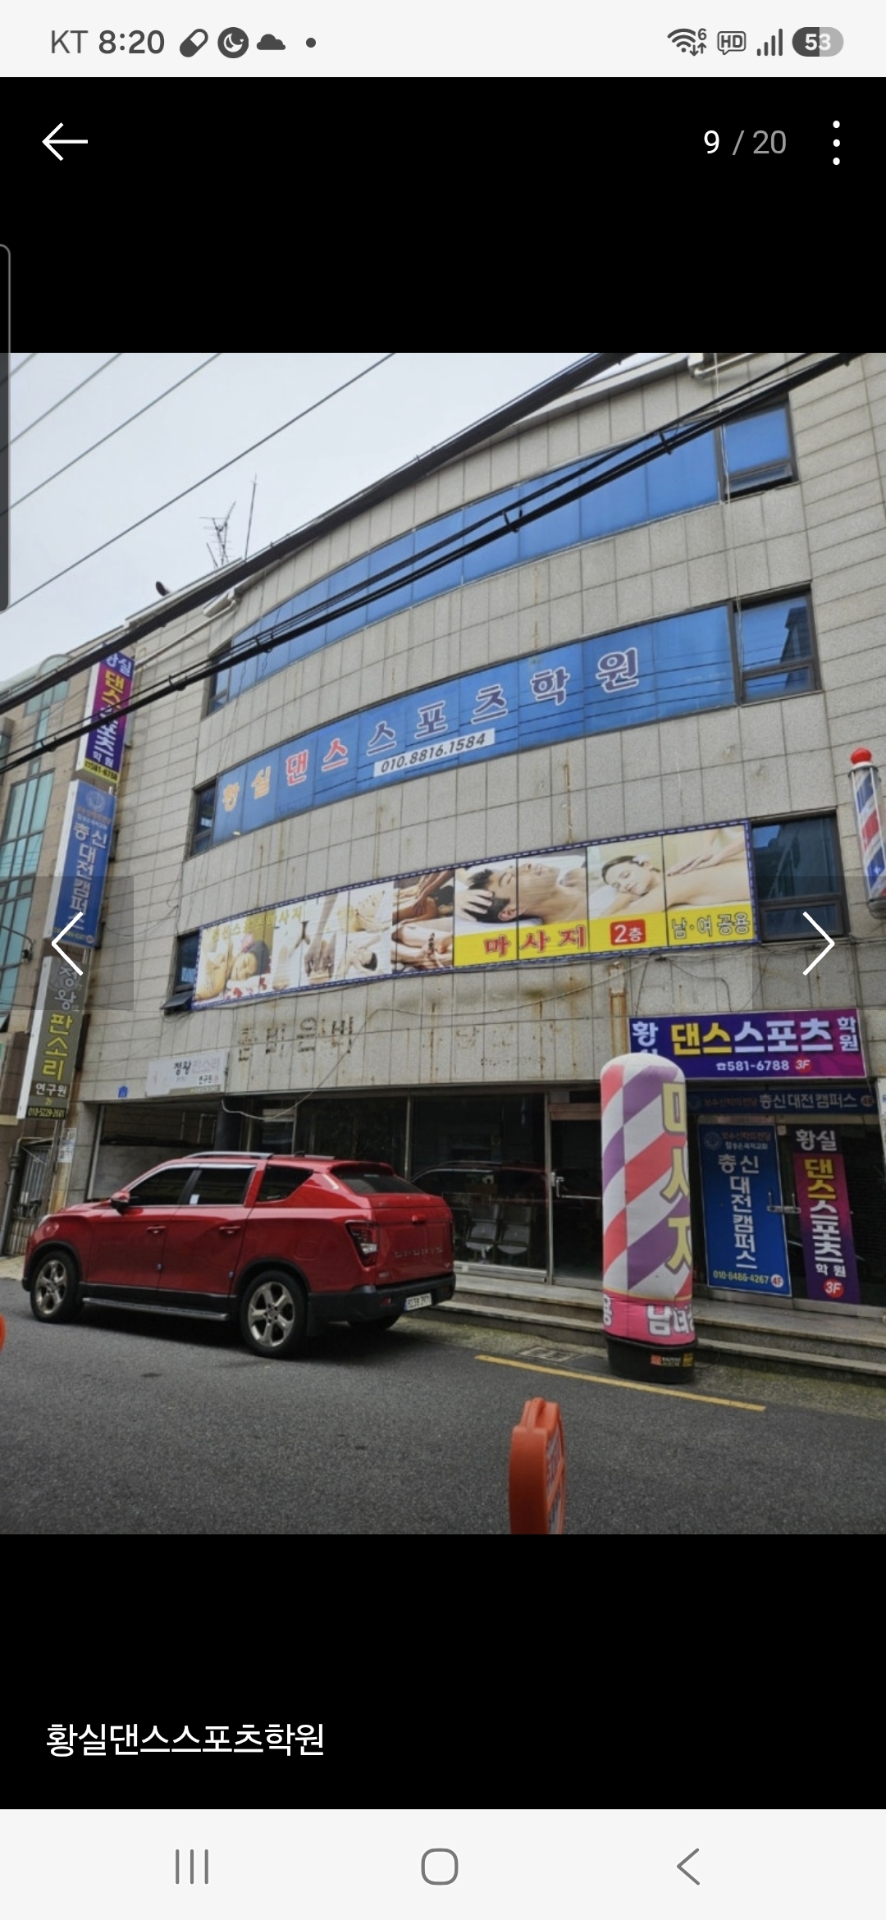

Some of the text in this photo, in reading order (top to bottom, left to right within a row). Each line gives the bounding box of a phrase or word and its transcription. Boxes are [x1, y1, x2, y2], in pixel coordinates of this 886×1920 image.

[379, 731, 488, 774] 010.8816.1584
[482, 925, 588, 957] 마사지
[613, 923, 643, 944] 2층
[42, 1012, 73, 1081] 판소리
[671, 1017, 834, 1056] 댄스스포츠
[836, 1016, 860, 1052] 학원
[727, 1059, 810, 1072] 581-6788 3F
[35, 1082, 68, 1098] 연구원
[795, 1128, 837, 1152] 황실
[717, 1153, 761, 1175] 총신
[729, 1176, 758, 1270] 대전캠퍼스
[803, 1158, 844, 1264] 댄스스포츠
[824, 1281, 841, 1294] 3F
